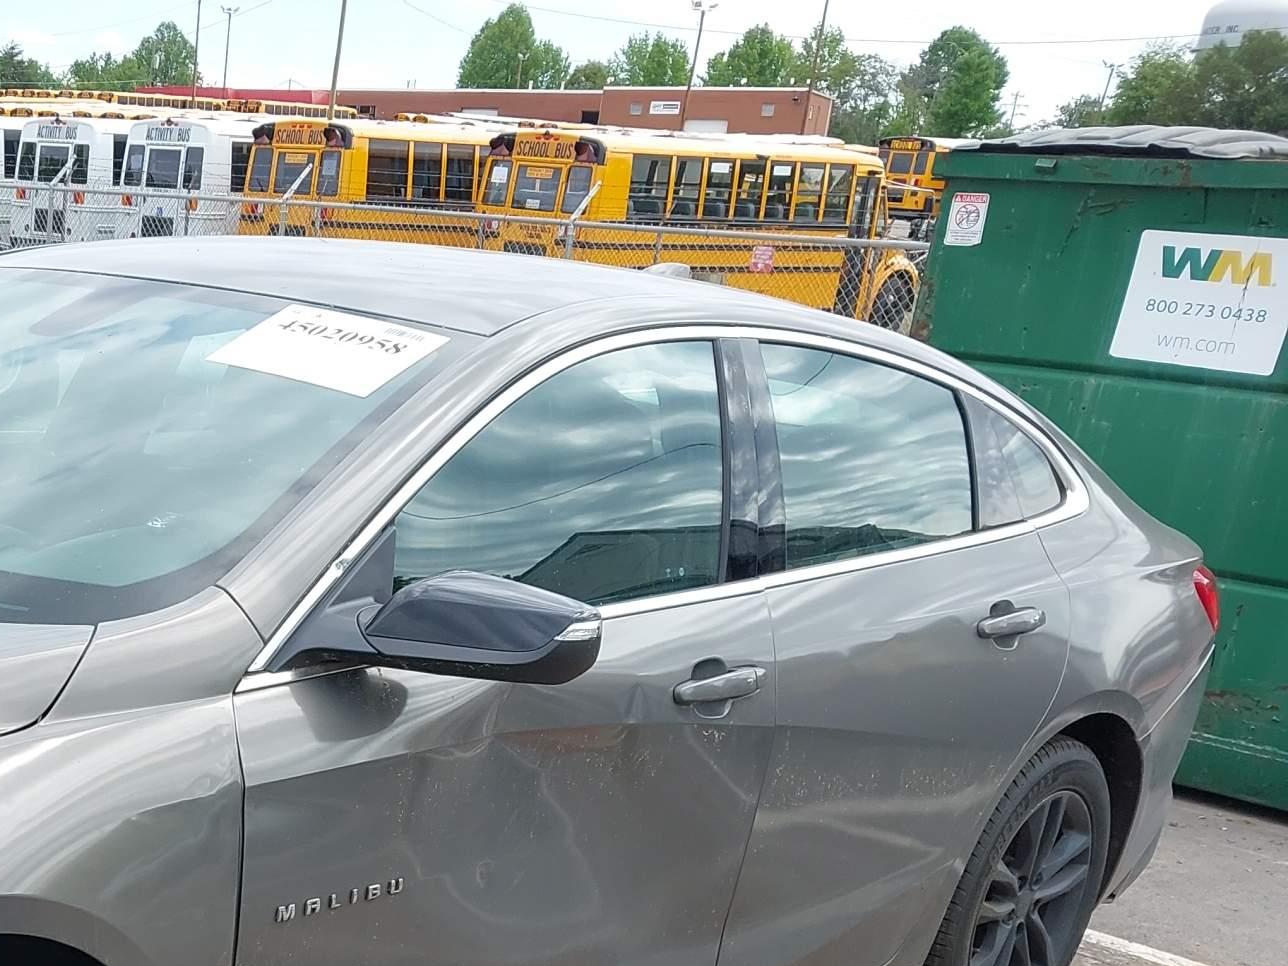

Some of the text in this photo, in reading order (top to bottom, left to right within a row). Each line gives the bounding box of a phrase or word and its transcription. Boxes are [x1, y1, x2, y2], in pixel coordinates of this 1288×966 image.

[37, 125, 78, 140] ACTIVITY BUS
[145, 127, 191, 142] ACTIVITY BUS
[276, 127, 324, 145] SCHOOL BUS
[517, 140, 574, 159] SCHOOL BUS
[1162, 245, 1273, 287] WM
[1145, 298, 1268, 323] 800 273 0438
[279, 319, 409, 356] 45020958
[1156, 333, 1237, 355] wm.com
[274, 877, 405, 923] MALIBU
